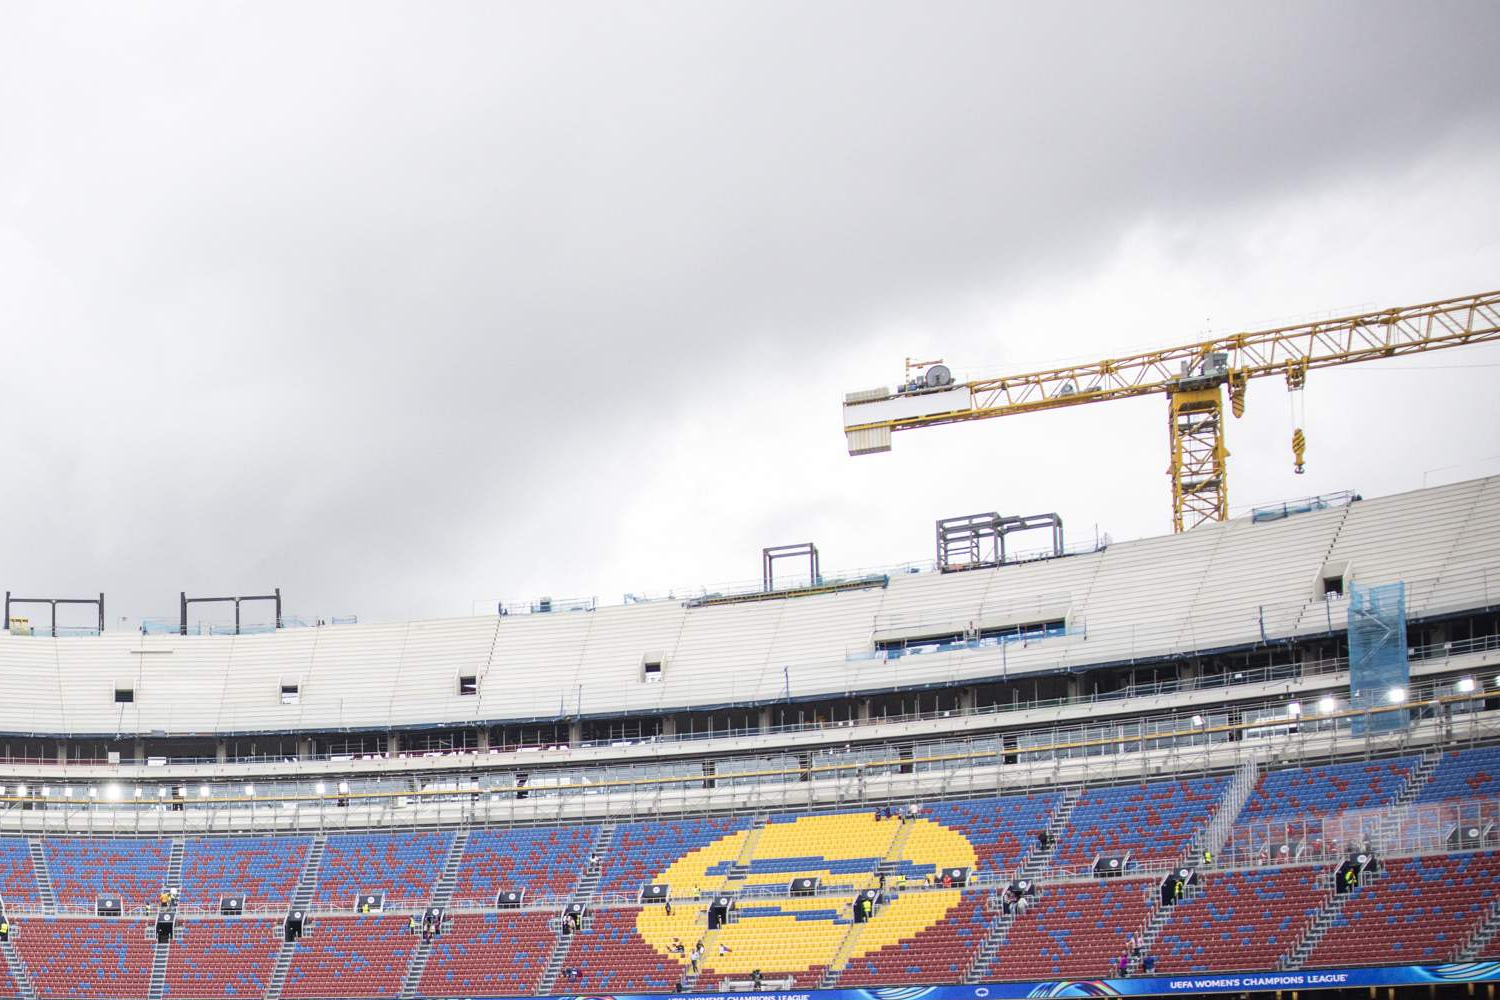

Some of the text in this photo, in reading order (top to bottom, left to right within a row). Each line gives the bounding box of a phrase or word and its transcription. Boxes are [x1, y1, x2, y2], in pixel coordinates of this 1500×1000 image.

[1170, 974, 1346, 989] UEFA WOMEN'S CHAMPIONS LEAGUE
